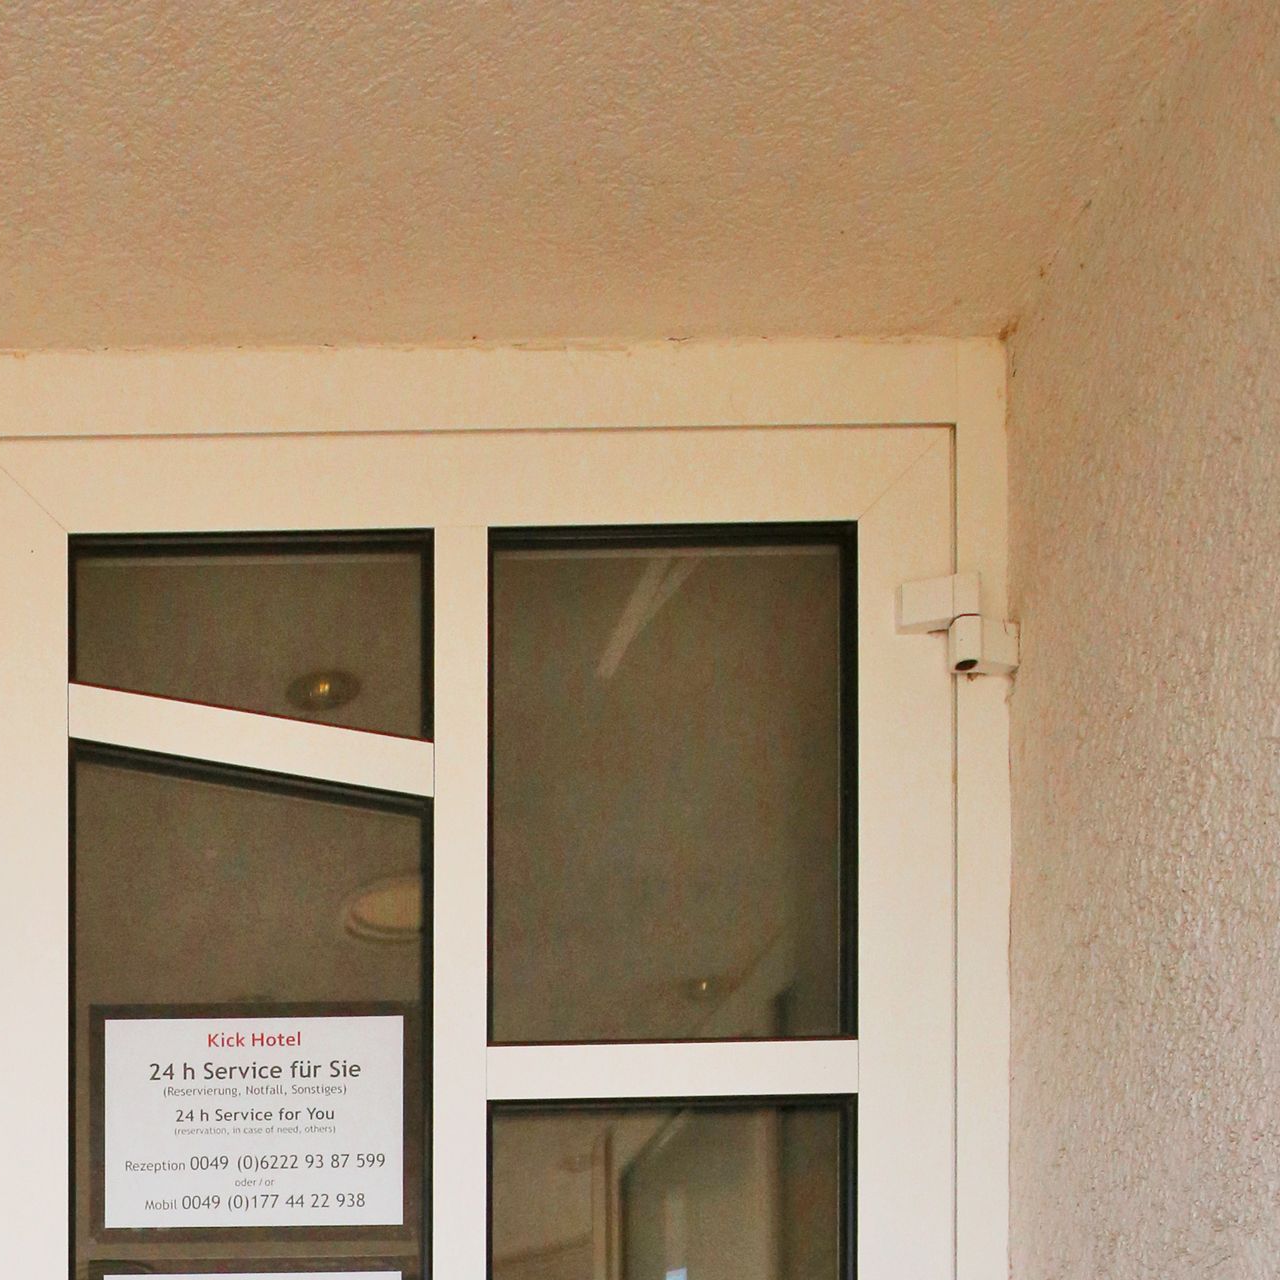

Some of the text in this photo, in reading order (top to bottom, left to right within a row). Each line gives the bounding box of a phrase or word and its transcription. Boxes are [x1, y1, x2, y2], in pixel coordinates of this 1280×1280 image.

[208, 1032, 301, 1048] Kick Hotel
[149, 1060, 361, 1080] 24 h Service für Sie
[163, 1084, 346, 1097] (Reservierung, Notfall, Sonstiges)
[176, 1107, 335, 1123] 24 h Service for You
[125, 1153, 386, 1174] Rezeption 0049 (0)6222 93 87 599
[235, 1178, 256, 1187] oder
[145, 1193, 365, 1211] Mobil 0049 (0)177 44 22 938
